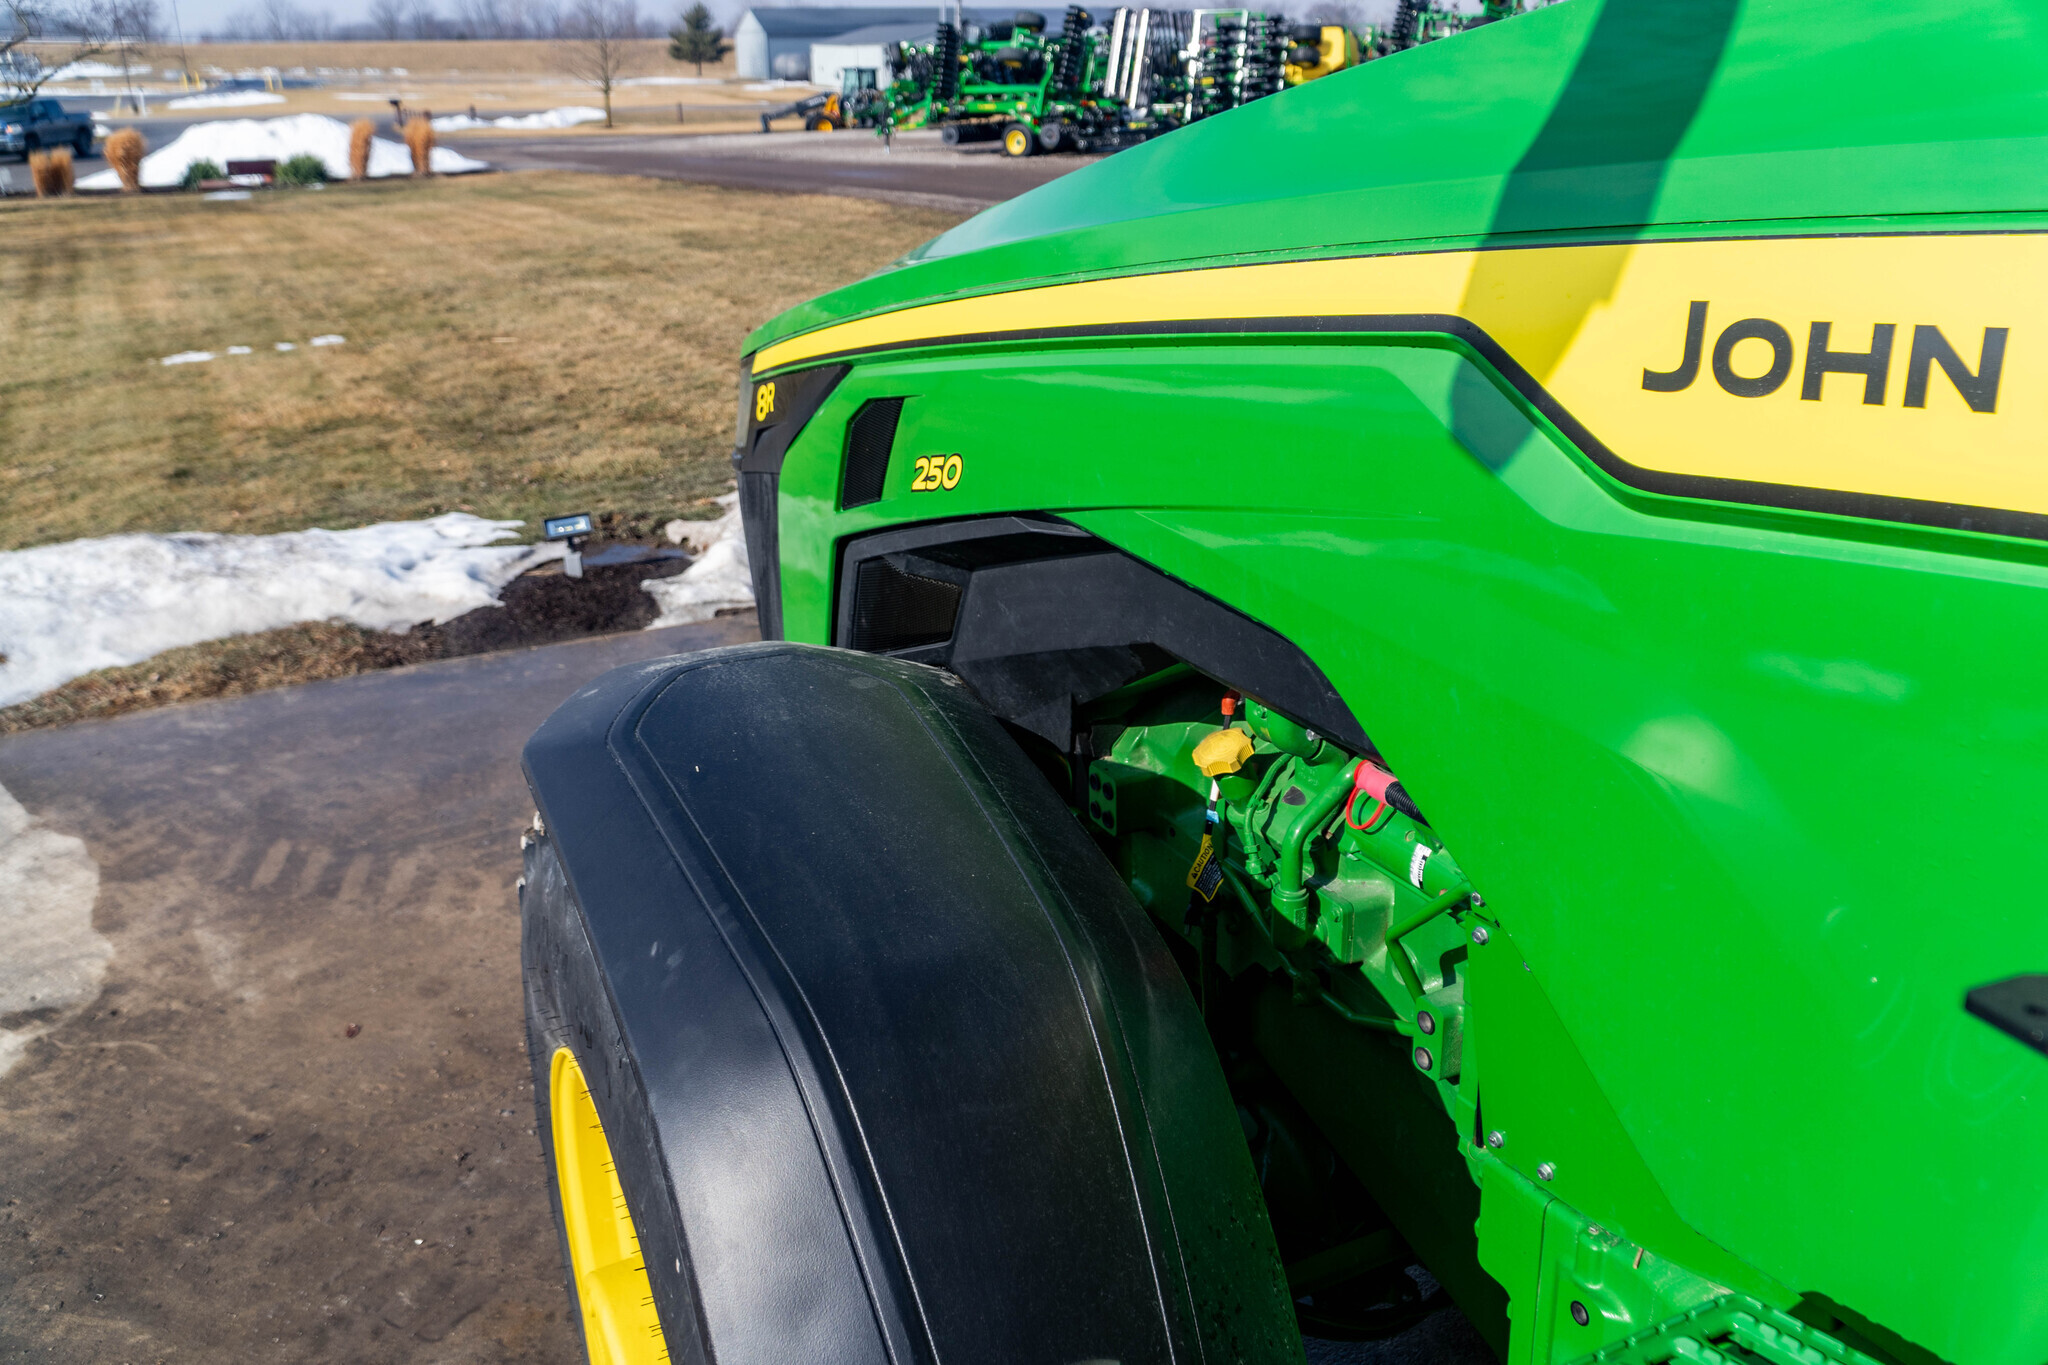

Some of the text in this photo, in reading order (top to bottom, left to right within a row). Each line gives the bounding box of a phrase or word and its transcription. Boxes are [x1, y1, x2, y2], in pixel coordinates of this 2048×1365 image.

[1641, 300, 2011, 414] JOHN
[756, 381, 776, 422] 8R
[911, 453, 963, 493] 250
[1193, 843, 1213, 873] CAUTION
